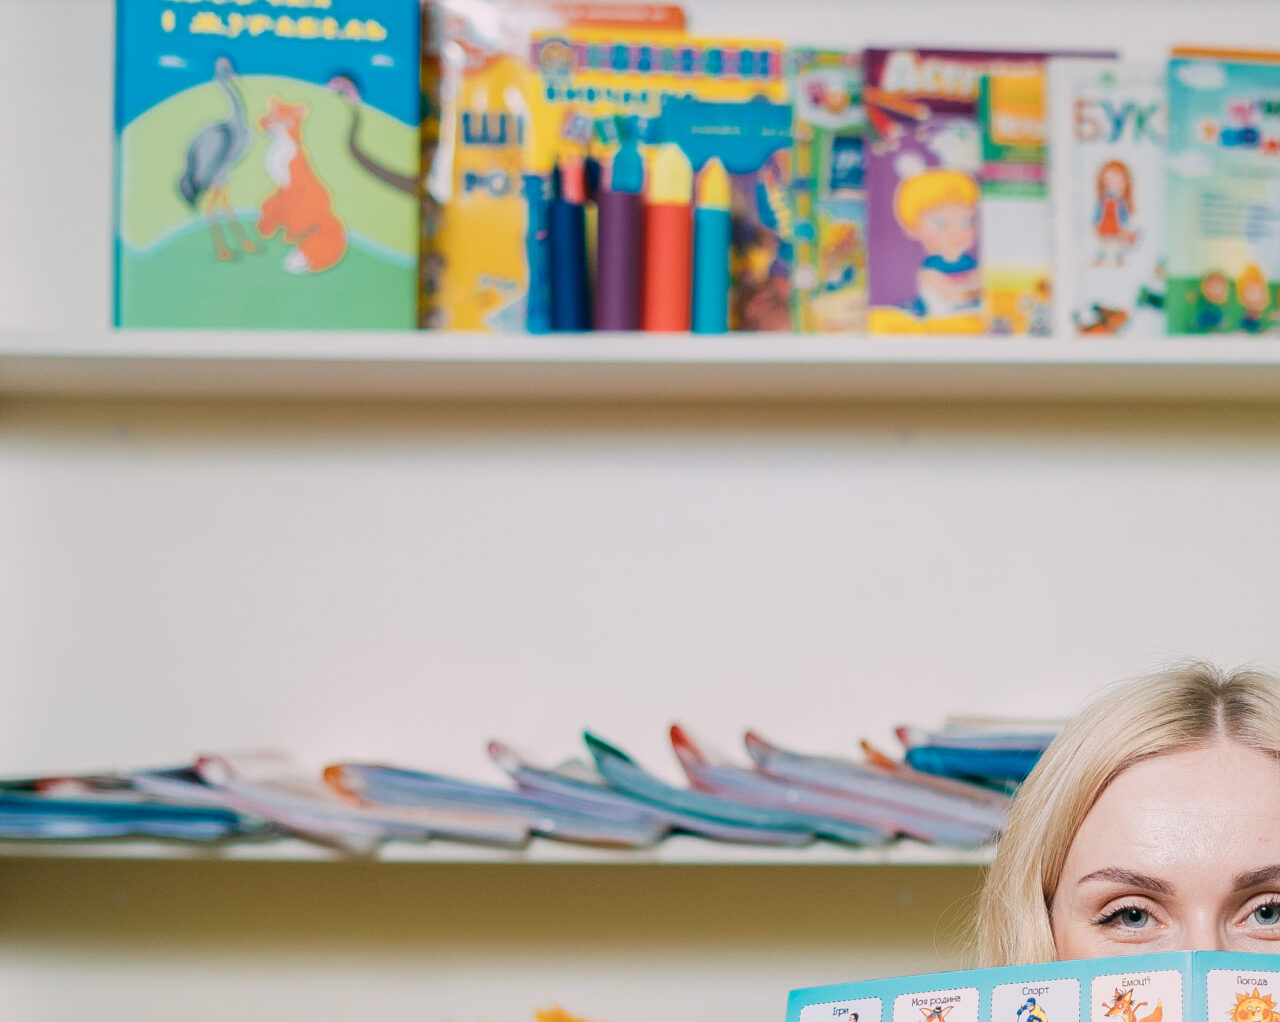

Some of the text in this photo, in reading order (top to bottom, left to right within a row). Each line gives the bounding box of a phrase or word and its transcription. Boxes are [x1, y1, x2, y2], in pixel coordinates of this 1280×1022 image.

[1236, 976, 1268, 986] Погода
[1022, 986, 1050, 997] Спорт
[912, 995, 961, 1007] Моя родина
[832, 1007, 849, 1017] Ігри
